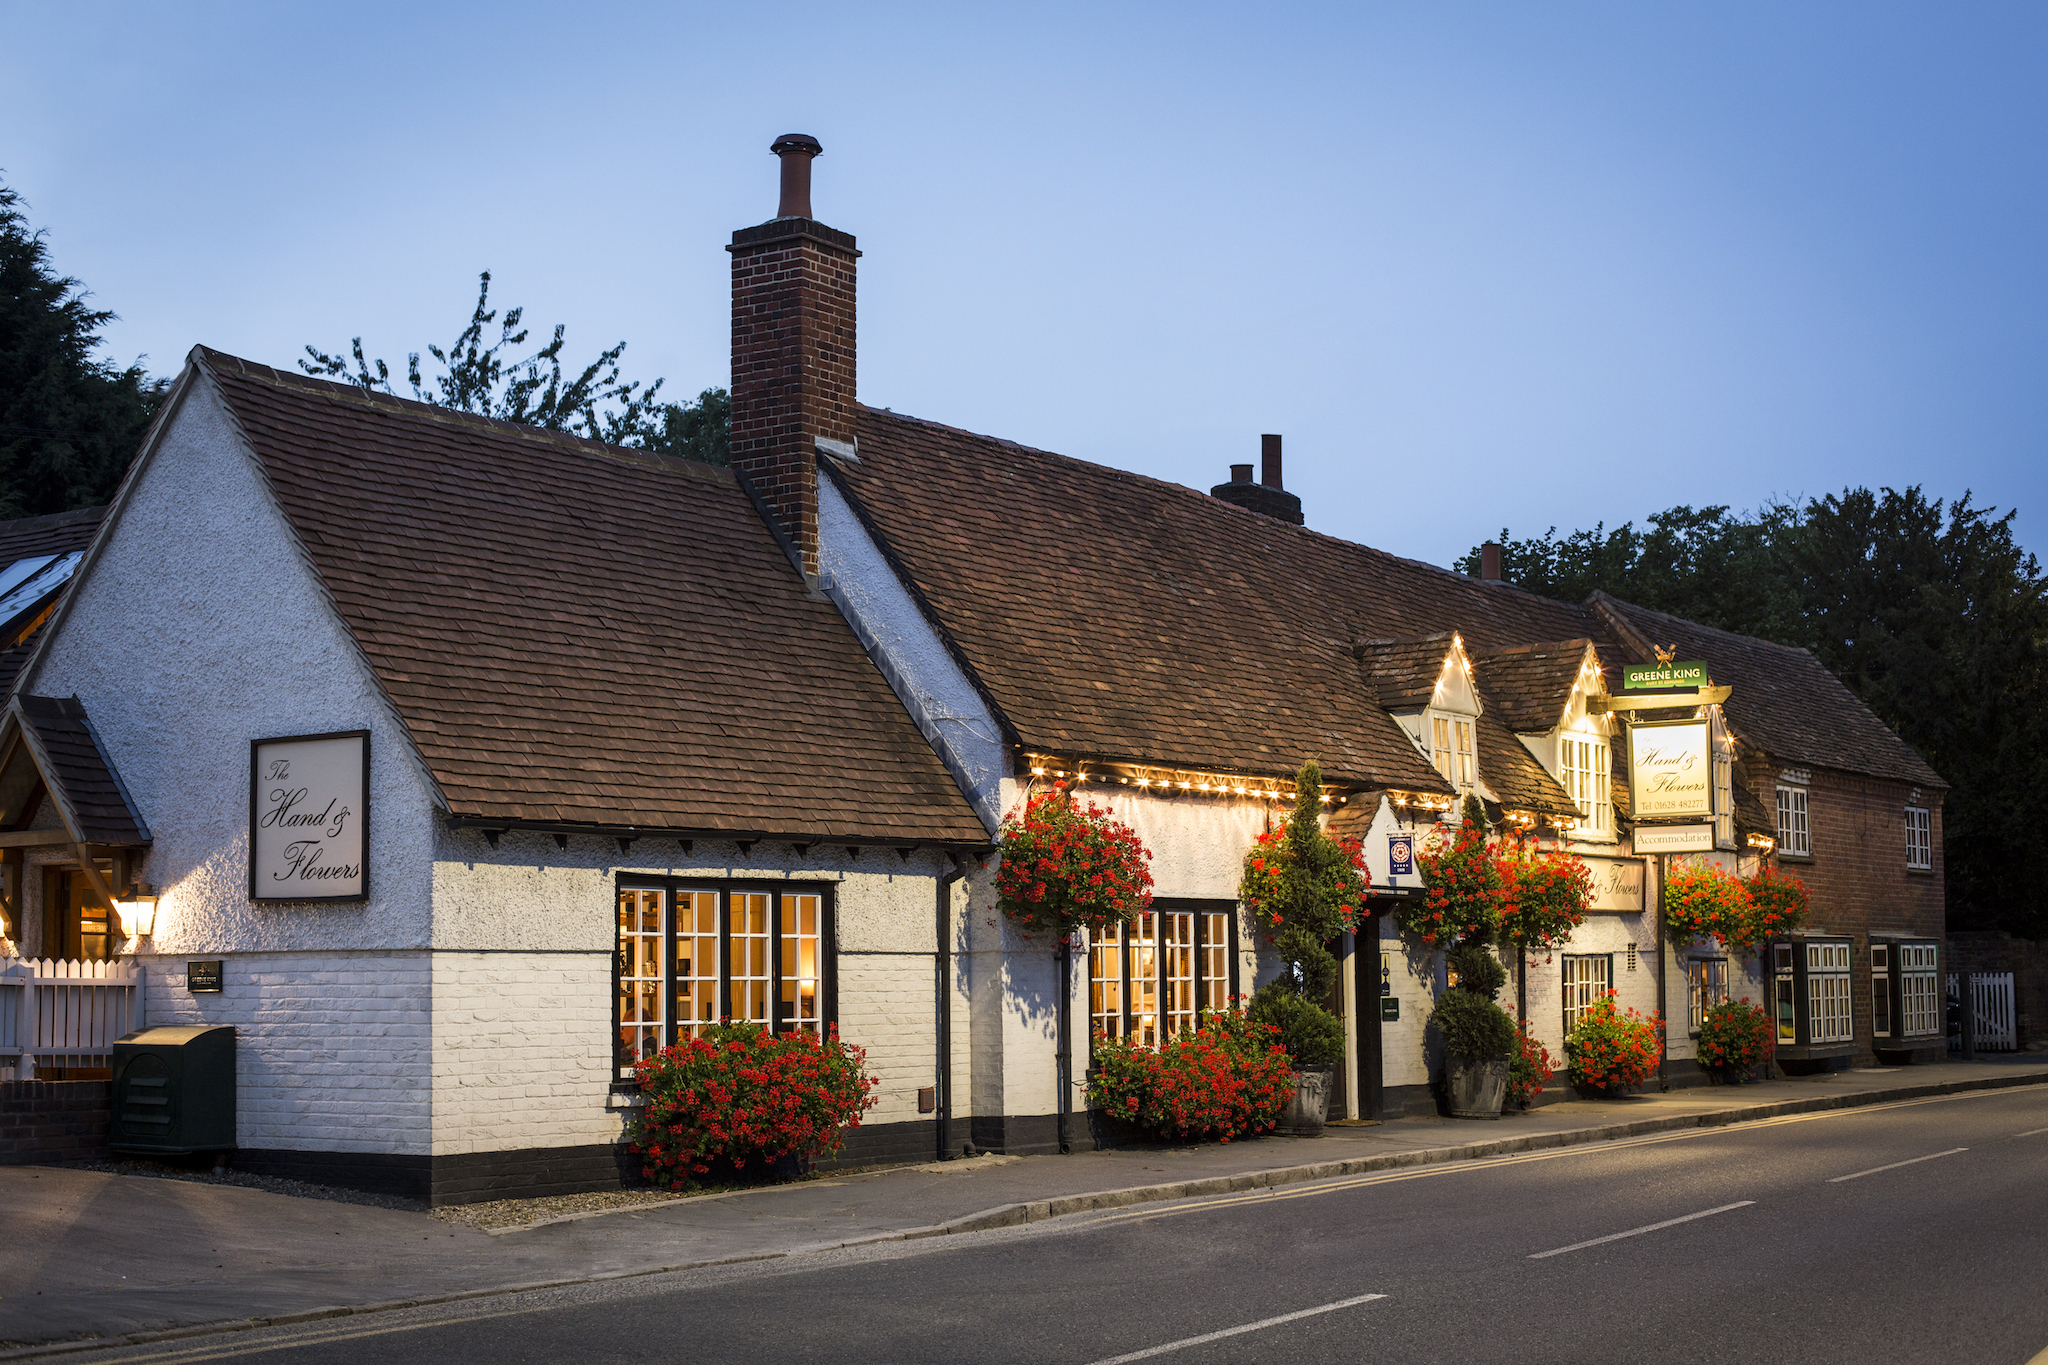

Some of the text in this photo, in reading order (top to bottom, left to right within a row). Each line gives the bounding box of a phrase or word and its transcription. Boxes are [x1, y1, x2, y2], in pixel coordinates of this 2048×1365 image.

[1630, 668, 1701, 682] GREENE KING
[265, 759, 290, 781] The
[1635, 746, 1698, 771] Hand &
[1646, 771, 1705, 794] Flowers
[261, 787, 351, 838] Hand &
[1640, 799, 1704, 811] Tel 01628 482277
[1636, 832, 1711, 845] Accommodation
[274, 840, 360, 882] Flowers
[1604, 863, 1640, 896] Flowers
